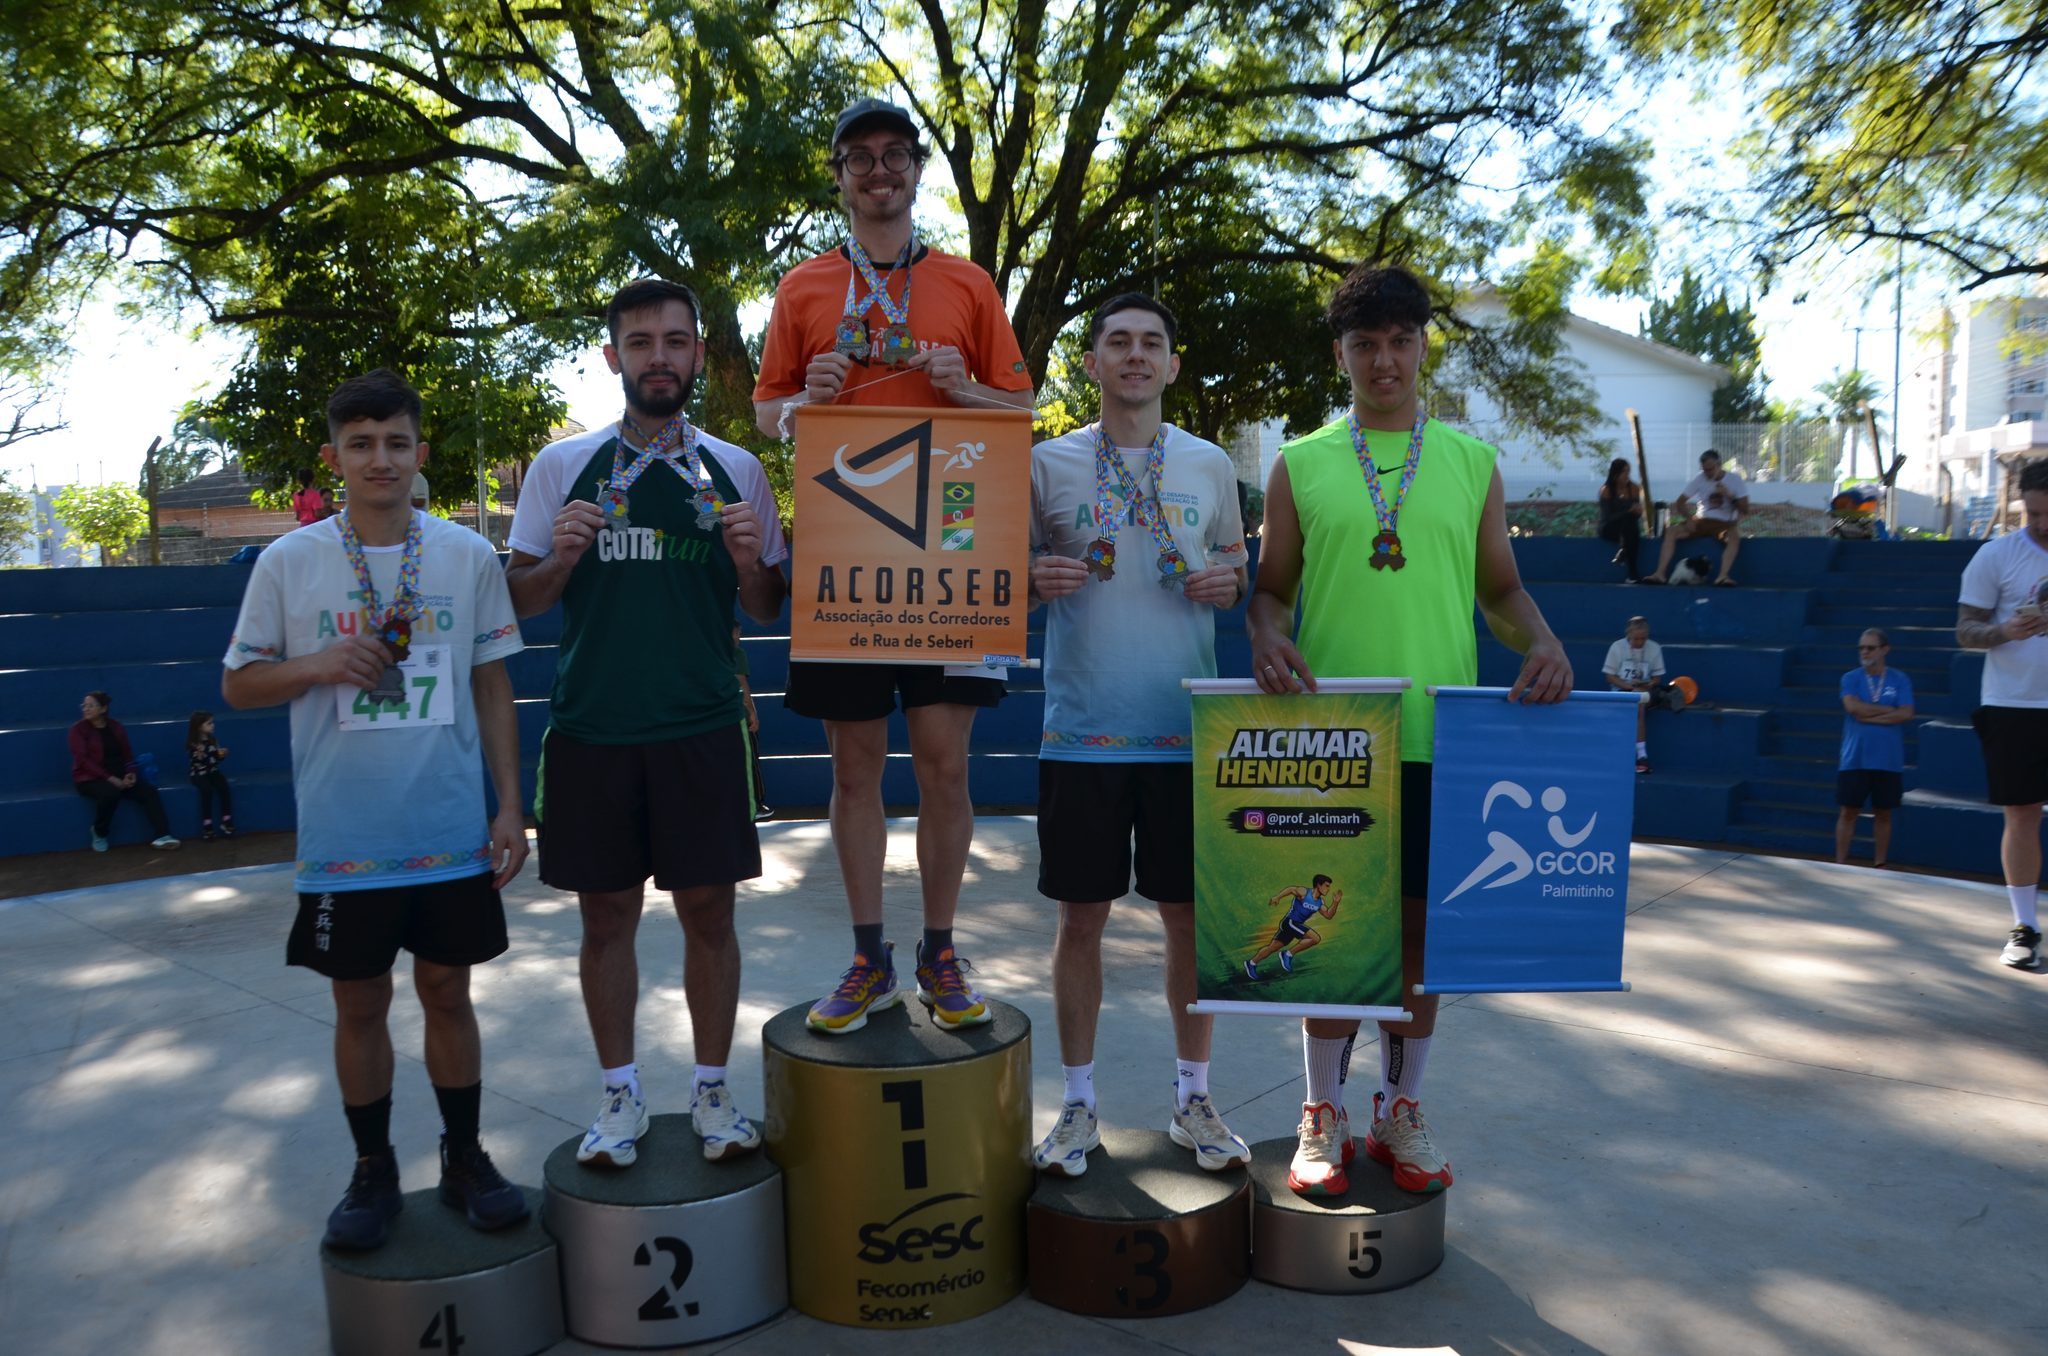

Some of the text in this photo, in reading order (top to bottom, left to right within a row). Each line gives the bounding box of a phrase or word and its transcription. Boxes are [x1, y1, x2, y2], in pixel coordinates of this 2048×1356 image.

[816, 565, 1011, 607] ACORSEB
[814, 609, 1010, 627] Associação dos Corredores
[849, 633, 974, 649] de Rua de Seberi
[1230, 730, 1368, 758] ALCIMAR
[1220, 759, 1367, 789] HENRIQUE
[1267, 812, 1360, 826] @prof_alcimarh
[1535, 851, 1616, 875] GCOR
[1542, 884, 1615, 898] Palmitinho
[881, 1079, 928, 1190] 1
[857, 1214, 984, 1265] Sesc
[1347, 1229, 1382, 1280] 5
[633, 1236, 699, 1322] 2
[857, 1268, 985, 1298] Fecomércio
[1115, 1229, 1173, 1311] 3
[859, 1303, 931, 1323] Senac
[419, 1303, 465, 1356] 4
